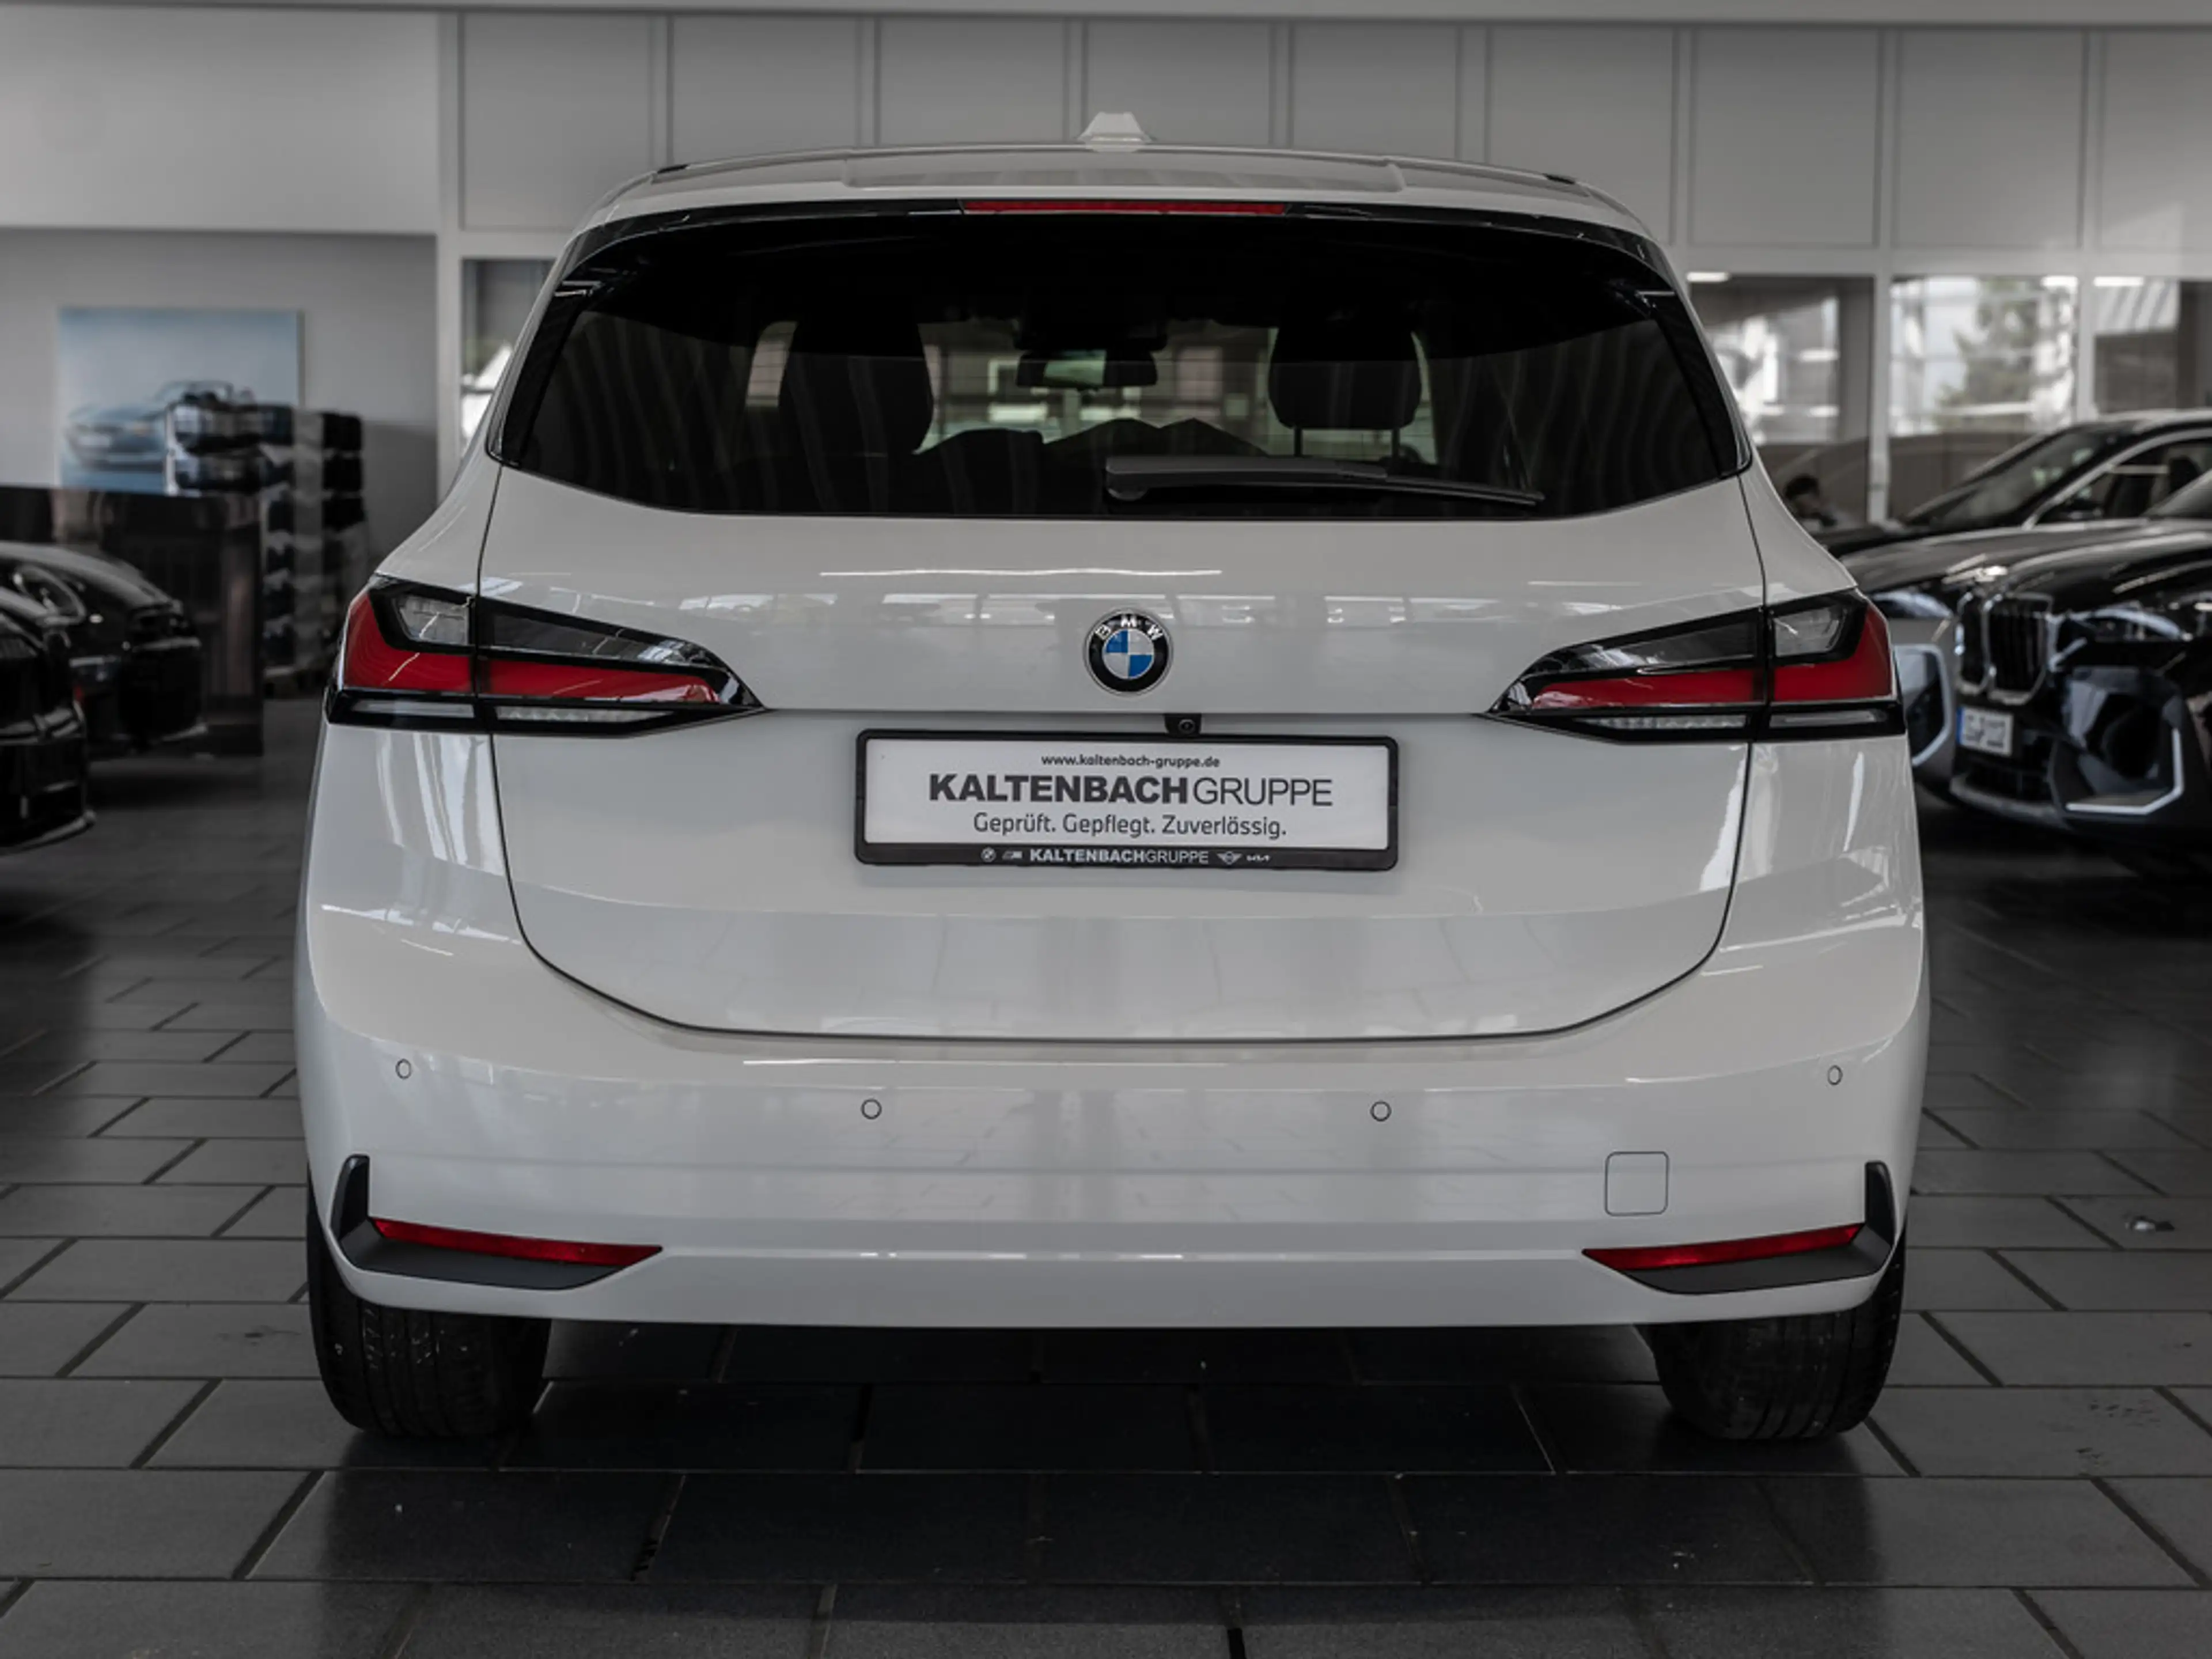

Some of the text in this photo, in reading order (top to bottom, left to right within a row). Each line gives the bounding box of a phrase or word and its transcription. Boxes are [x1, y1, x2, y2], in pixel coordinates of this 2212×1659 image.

[1095, 615, 1164, 641] BMW
[1041, 754, 1220, 769] www.kaltenbach-gruppe.de
[974, 812, 1287, 840] Geprüft. Gepflegt. Zuverlässig.
[1029, 848, 1209, 863] KALTENBACHGRUPPE
